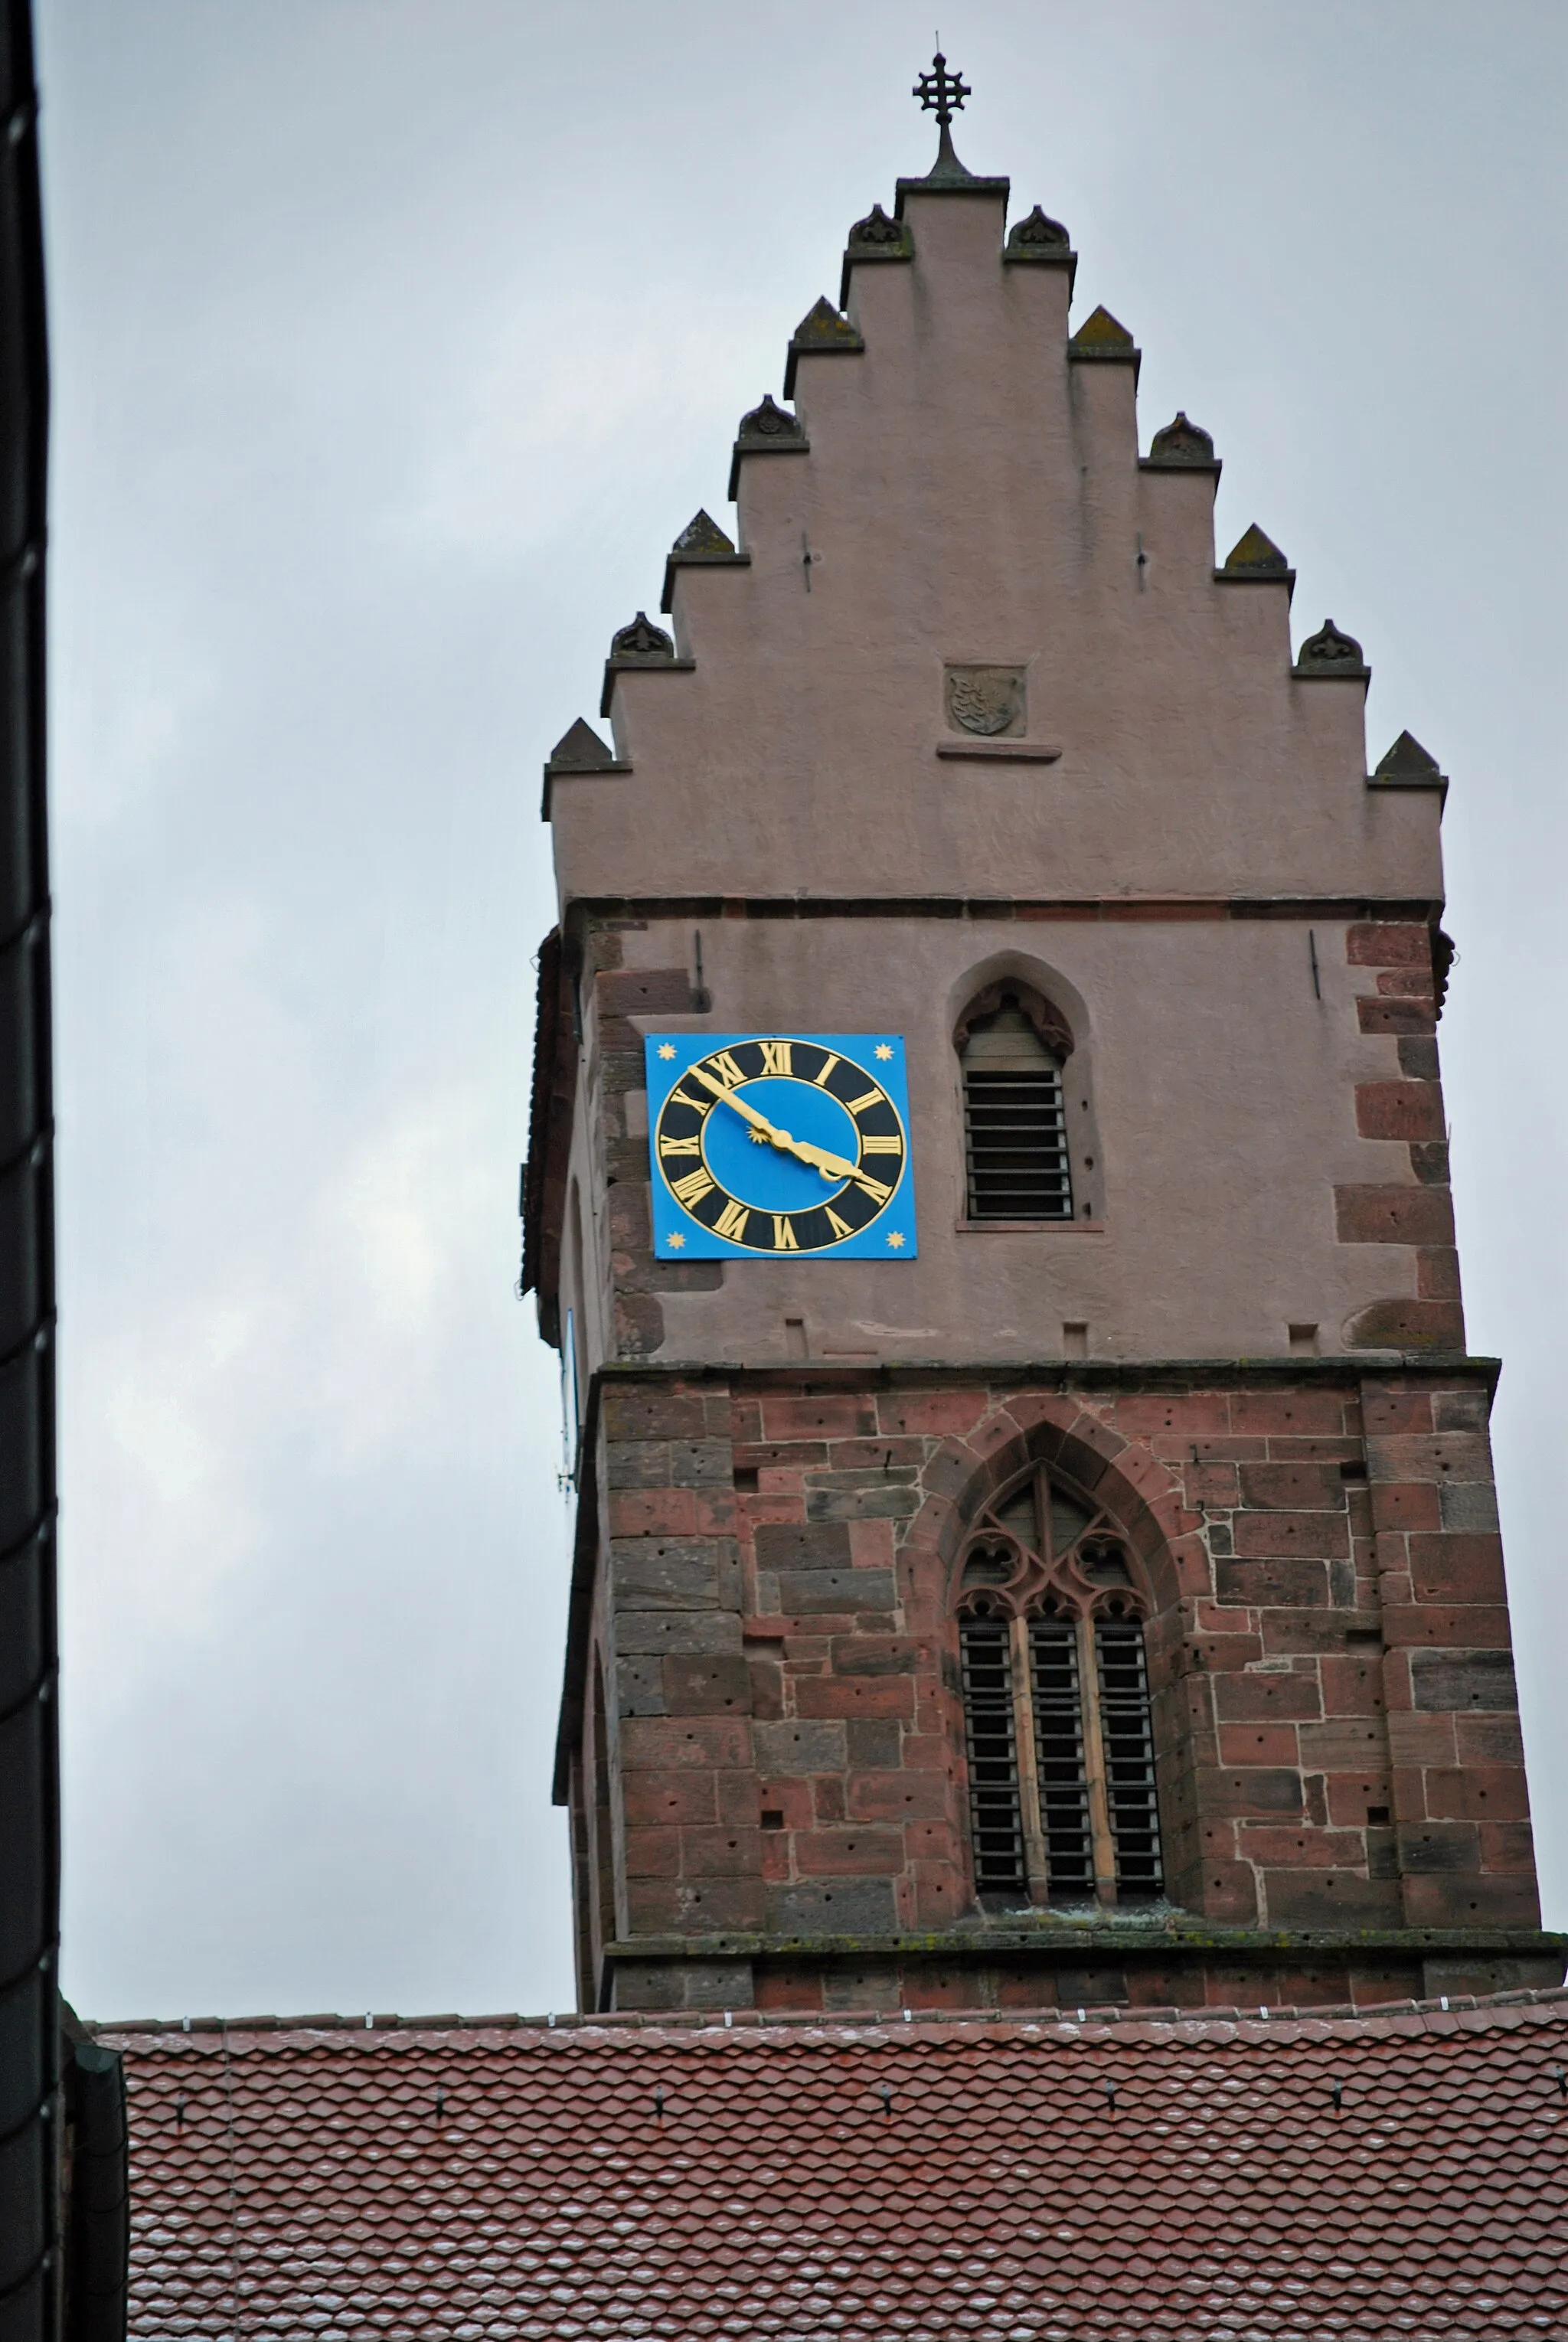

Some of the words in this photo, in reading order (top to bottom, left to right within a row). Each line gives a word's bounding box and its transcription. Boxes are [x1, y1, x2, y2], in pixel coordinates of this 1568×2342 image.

[705, 1051, 748, 1088] XI
[758, 1042, 794, 1076] XII
[813, 1053, 841, 1086] I
[670, 1087, 711, 1115] X
[845, 1087, 887, 1115] II
[660, 1134, 701, 1157] IX
[861, 1135, 902, 1155] III
[671, 1166, 715, 1210] VIII
[711, 1199, 750, 1241] VII
[772, 1215, 799, 1249] VI
[825, 1206, 854, 1239] V
